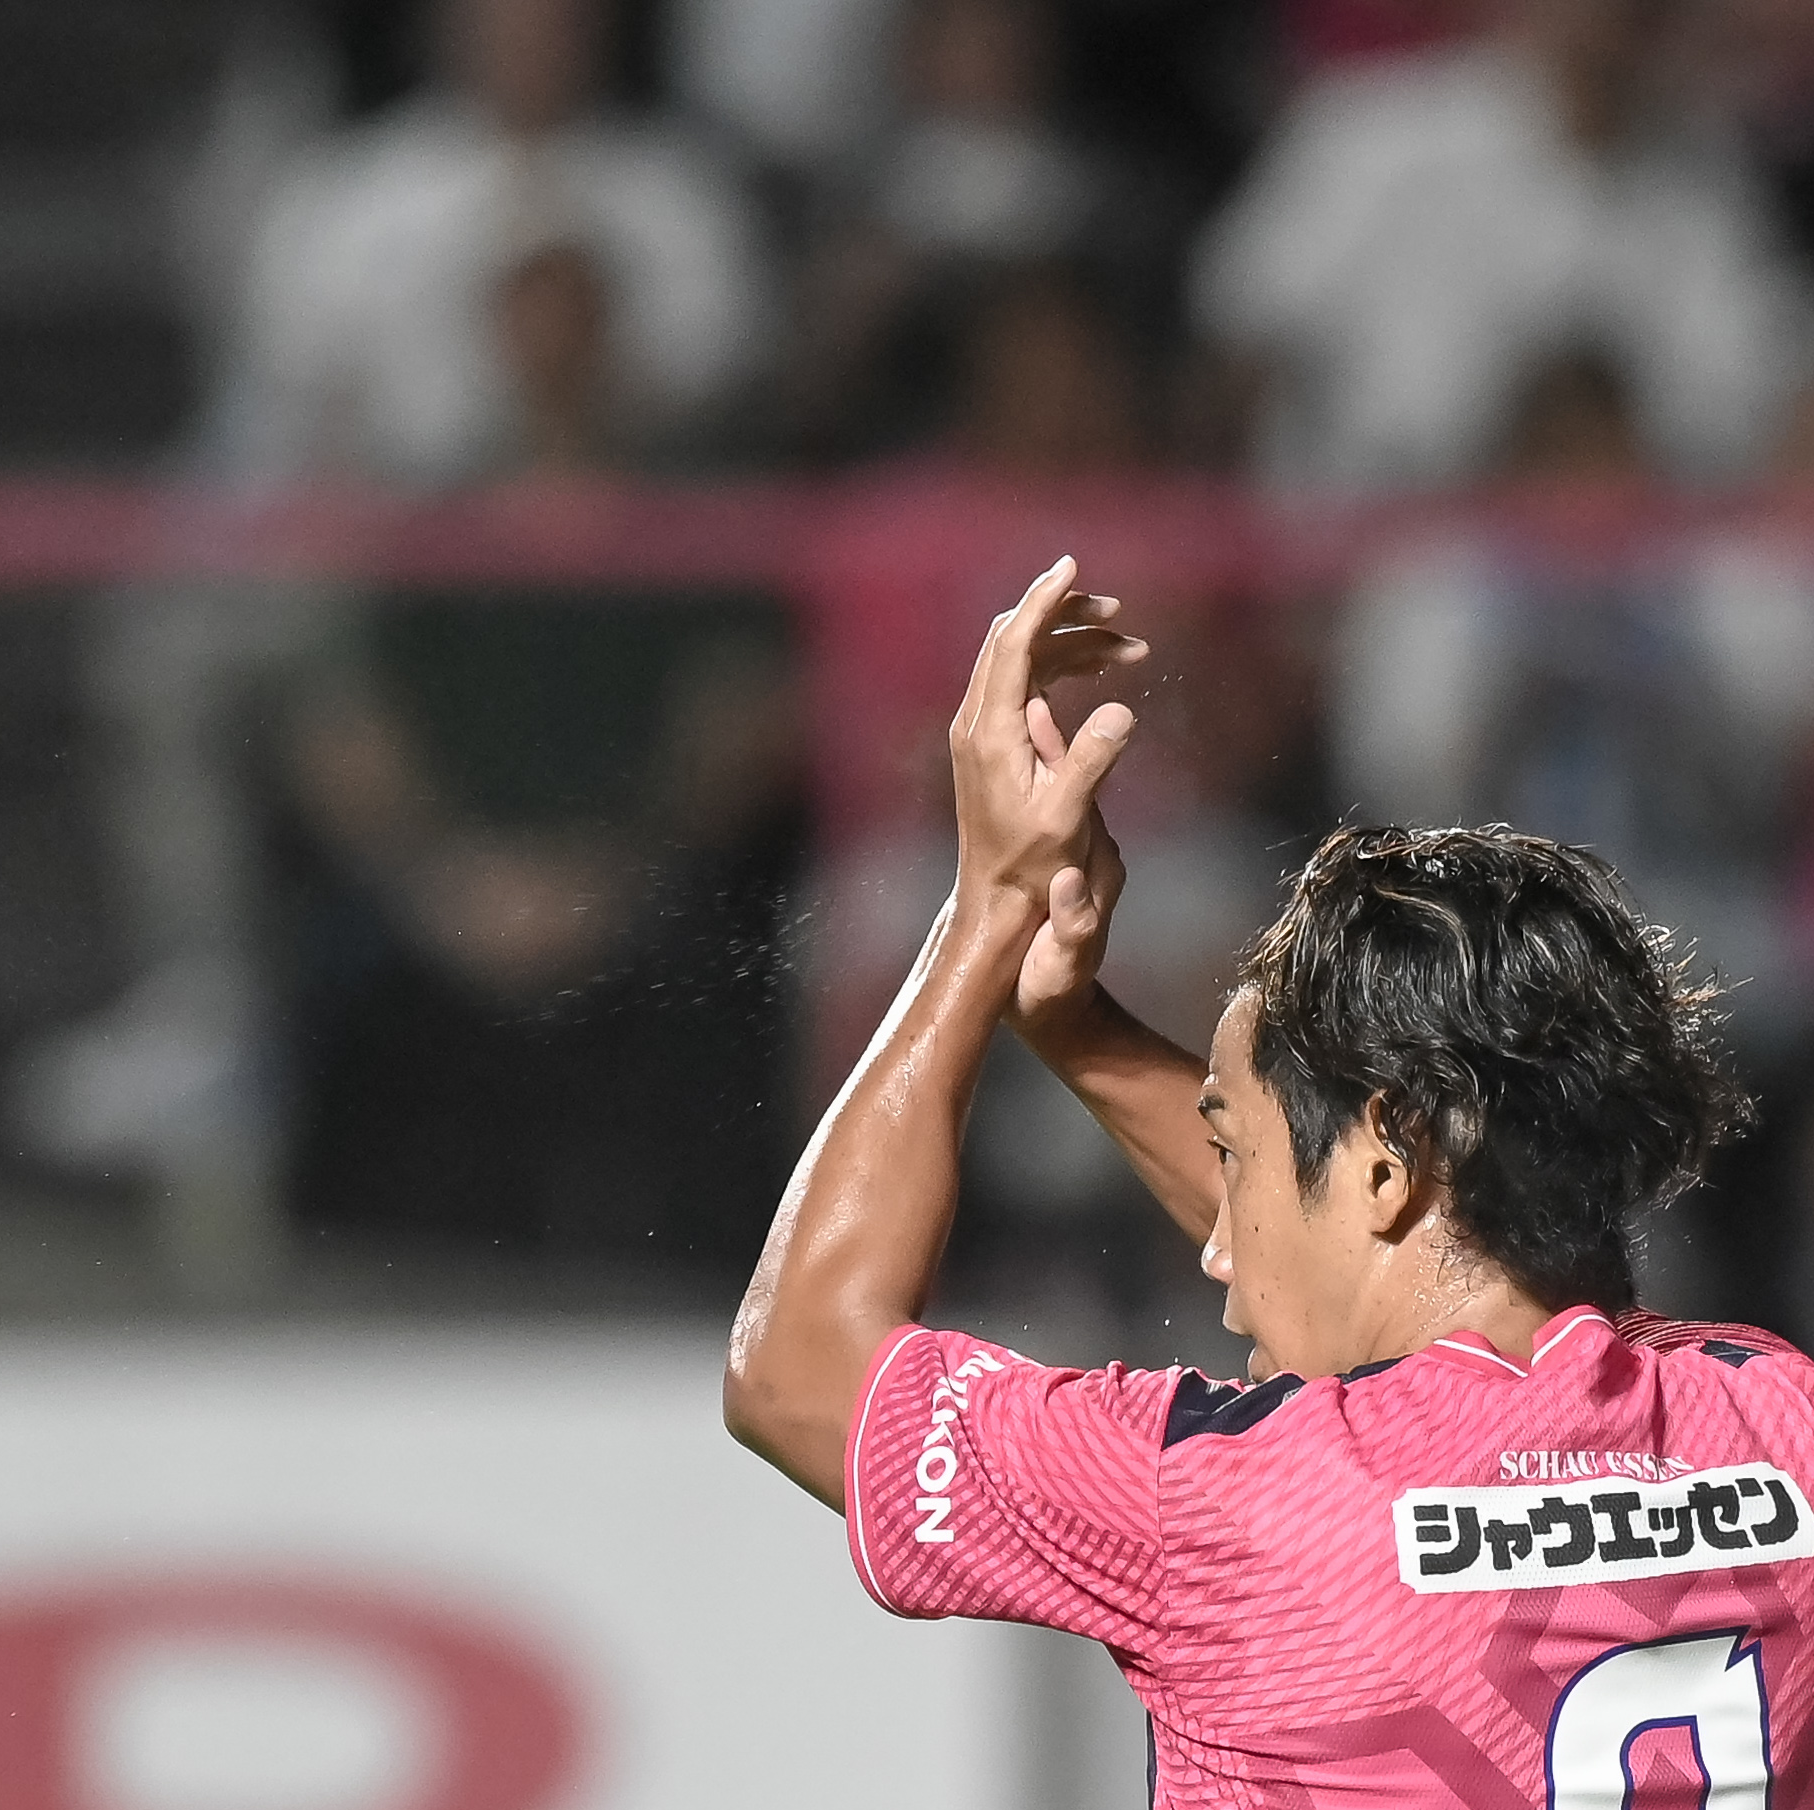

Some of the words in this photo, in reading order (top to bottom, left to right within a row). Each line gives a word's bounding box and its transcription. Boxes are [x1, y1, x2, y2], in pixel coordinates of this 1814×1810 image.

[1499, 1449, 1600, 1480] SCHAU
[1412, 1476, 1801, 1577] シャウエッセン
